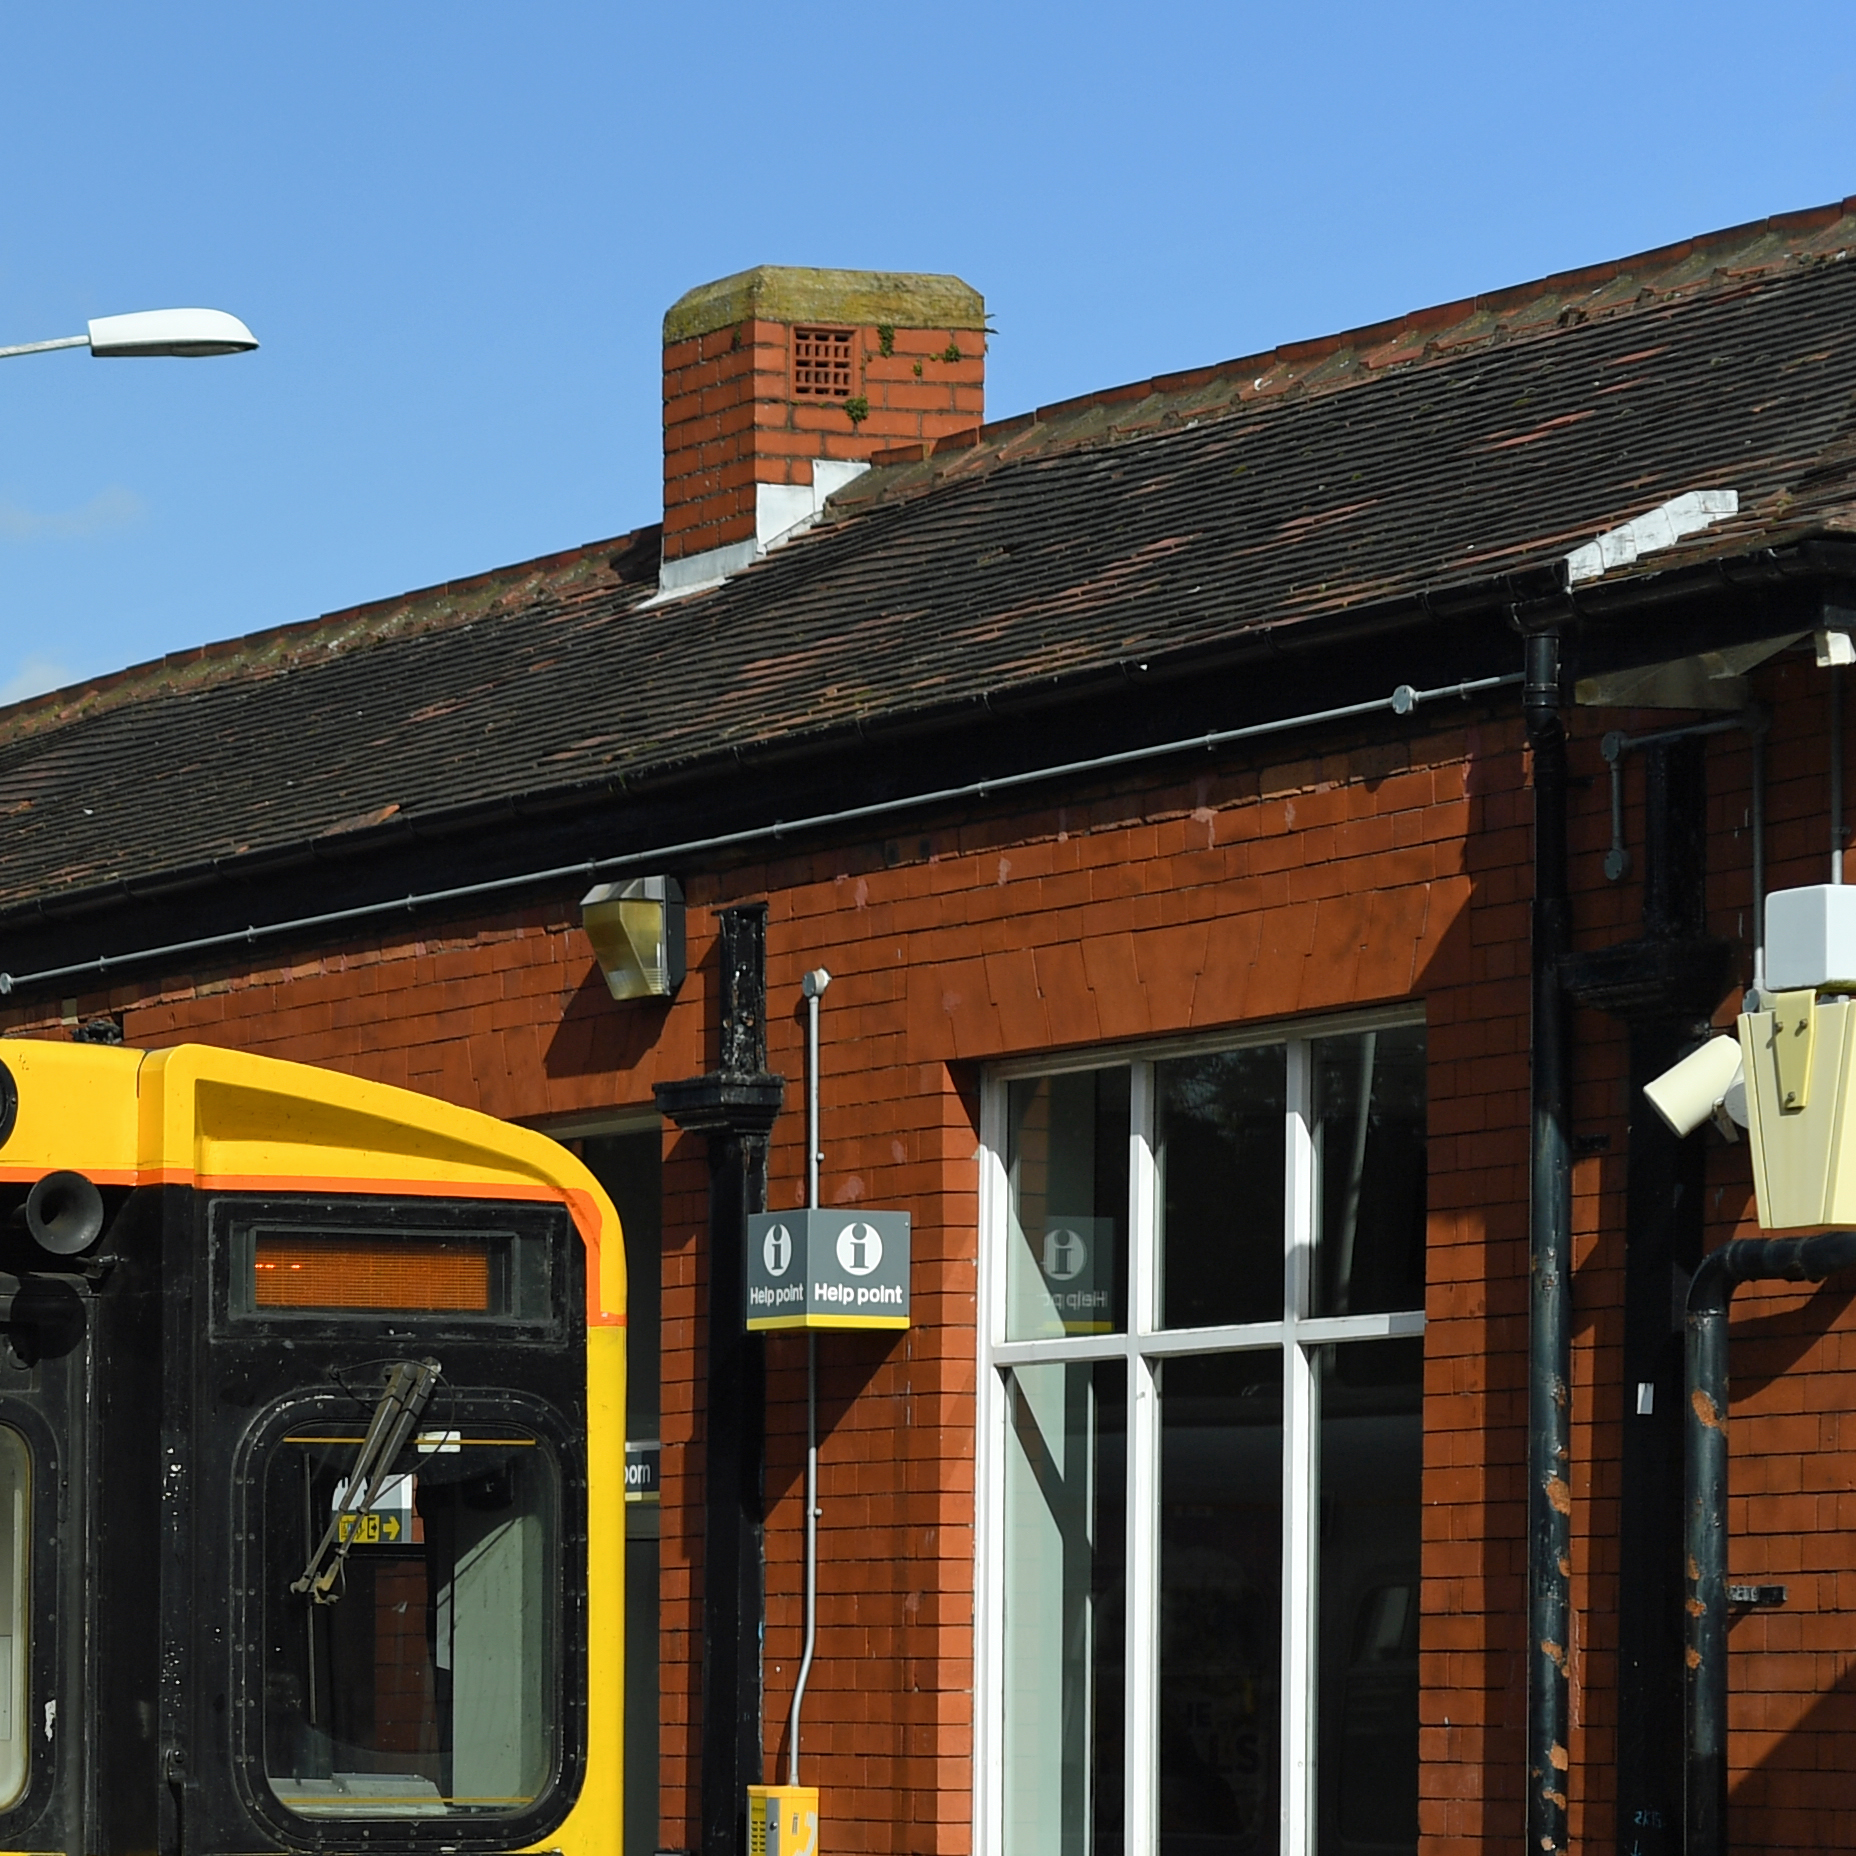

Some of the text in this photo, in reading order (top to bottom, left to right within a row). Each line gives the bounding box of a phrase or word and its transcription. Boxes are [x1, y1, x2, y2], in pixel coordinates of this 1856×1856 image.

[750, 1283, 804, 1307] Help point
[814, 1282, 903, 1306] Help point
